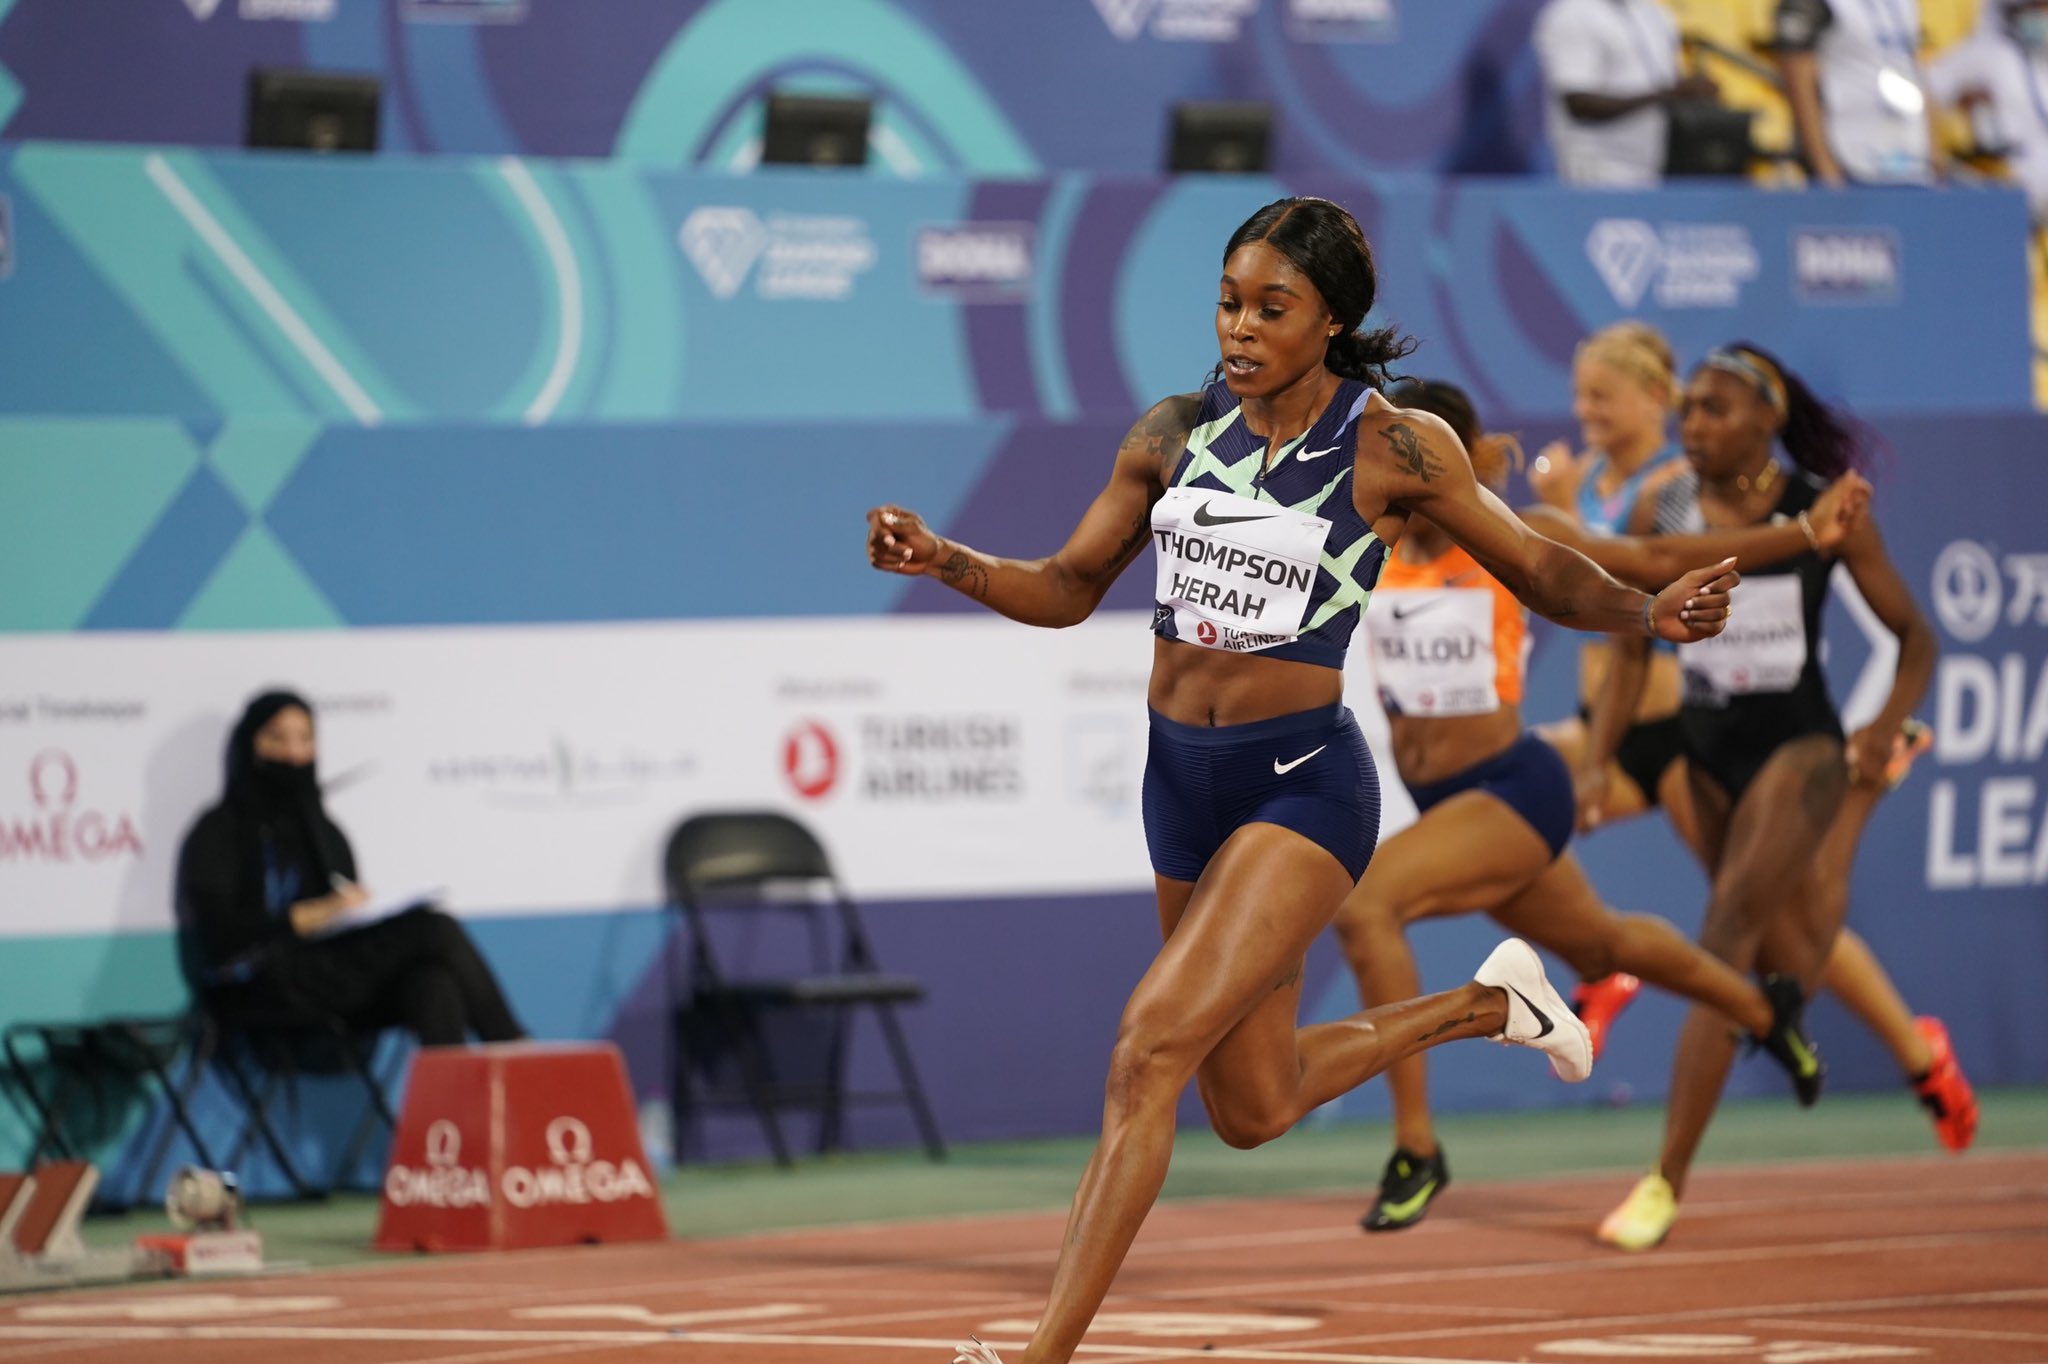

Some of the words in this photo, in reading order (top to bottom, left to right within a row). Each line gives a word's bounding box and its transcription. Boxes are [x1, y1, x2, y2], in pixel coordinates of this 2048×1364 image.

[1154, 529, 1312, 593] THOMPSON
[1170, 572, 1267, 620] HERAH
[1414, 634, 1477, 664] LOU
[1926, 776, 2048, 890] LE
[386, 1164, 491, 1208] OMEGA
[502, 1159, 652, 1208] OMEGA
